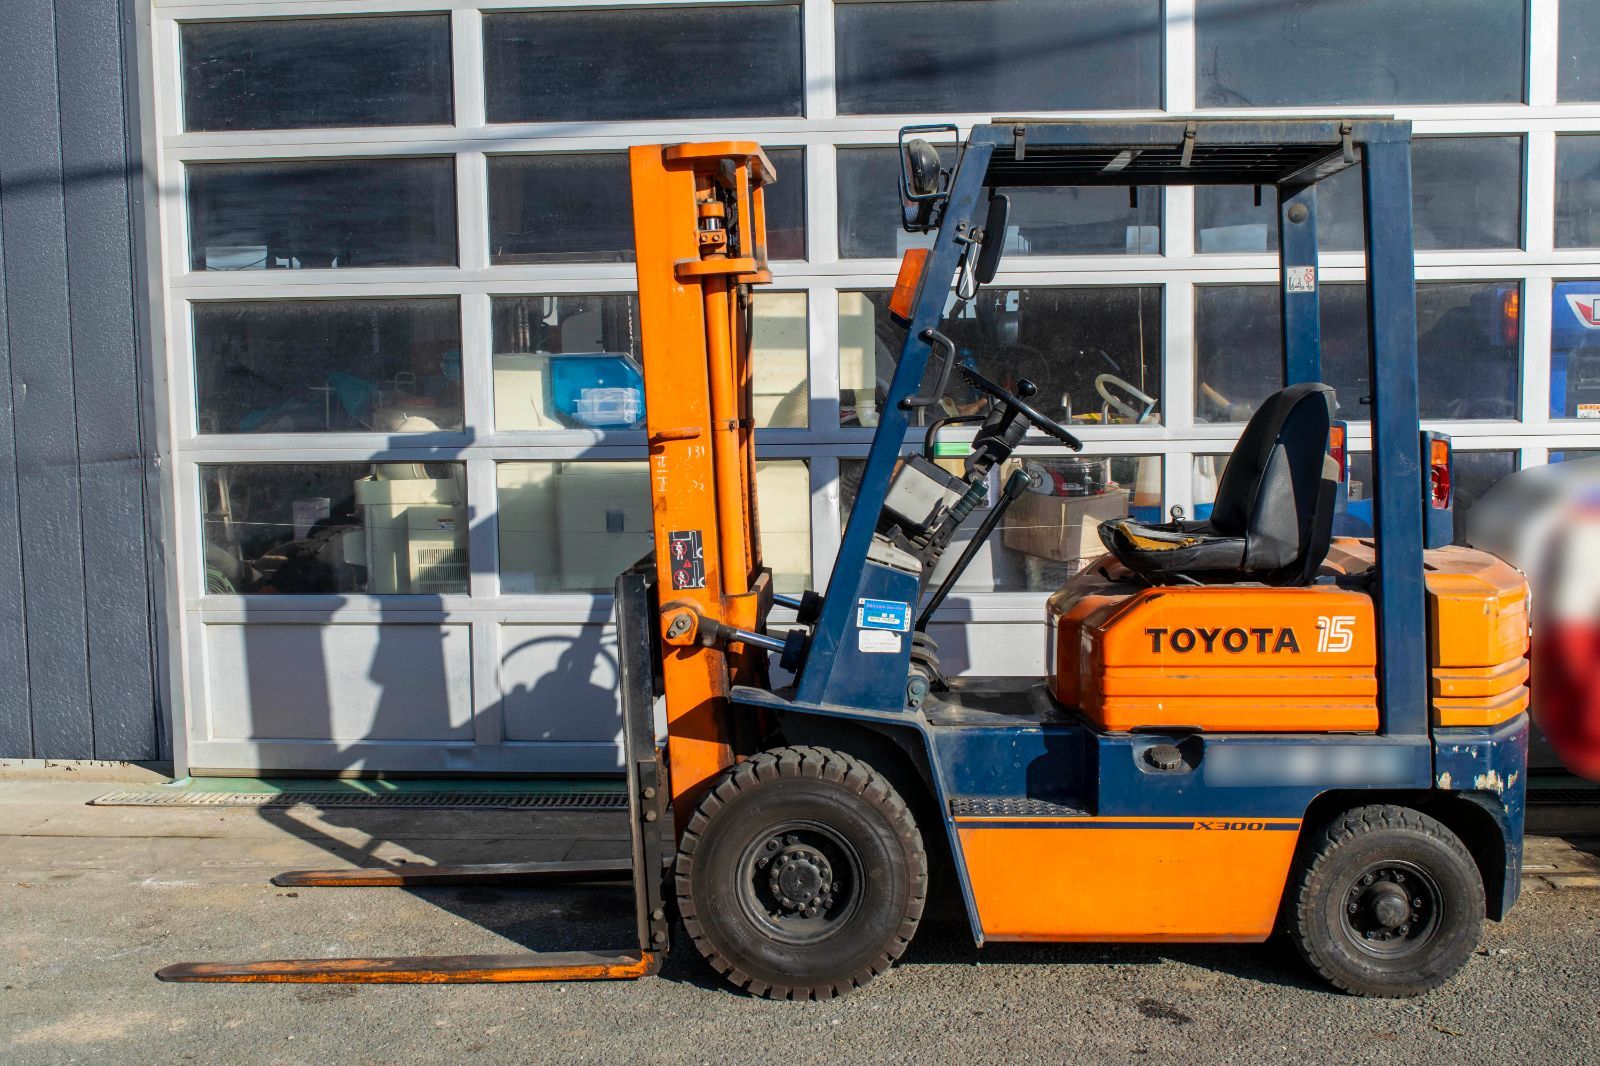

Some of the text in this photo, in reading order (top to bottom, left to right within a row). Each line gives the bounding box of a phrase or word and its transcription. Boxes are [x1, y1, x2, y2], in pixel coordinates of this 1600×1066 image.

[1145, 615, 1356, 653] TOYOTA 15
[1194, 821, 1264, 831] X300
